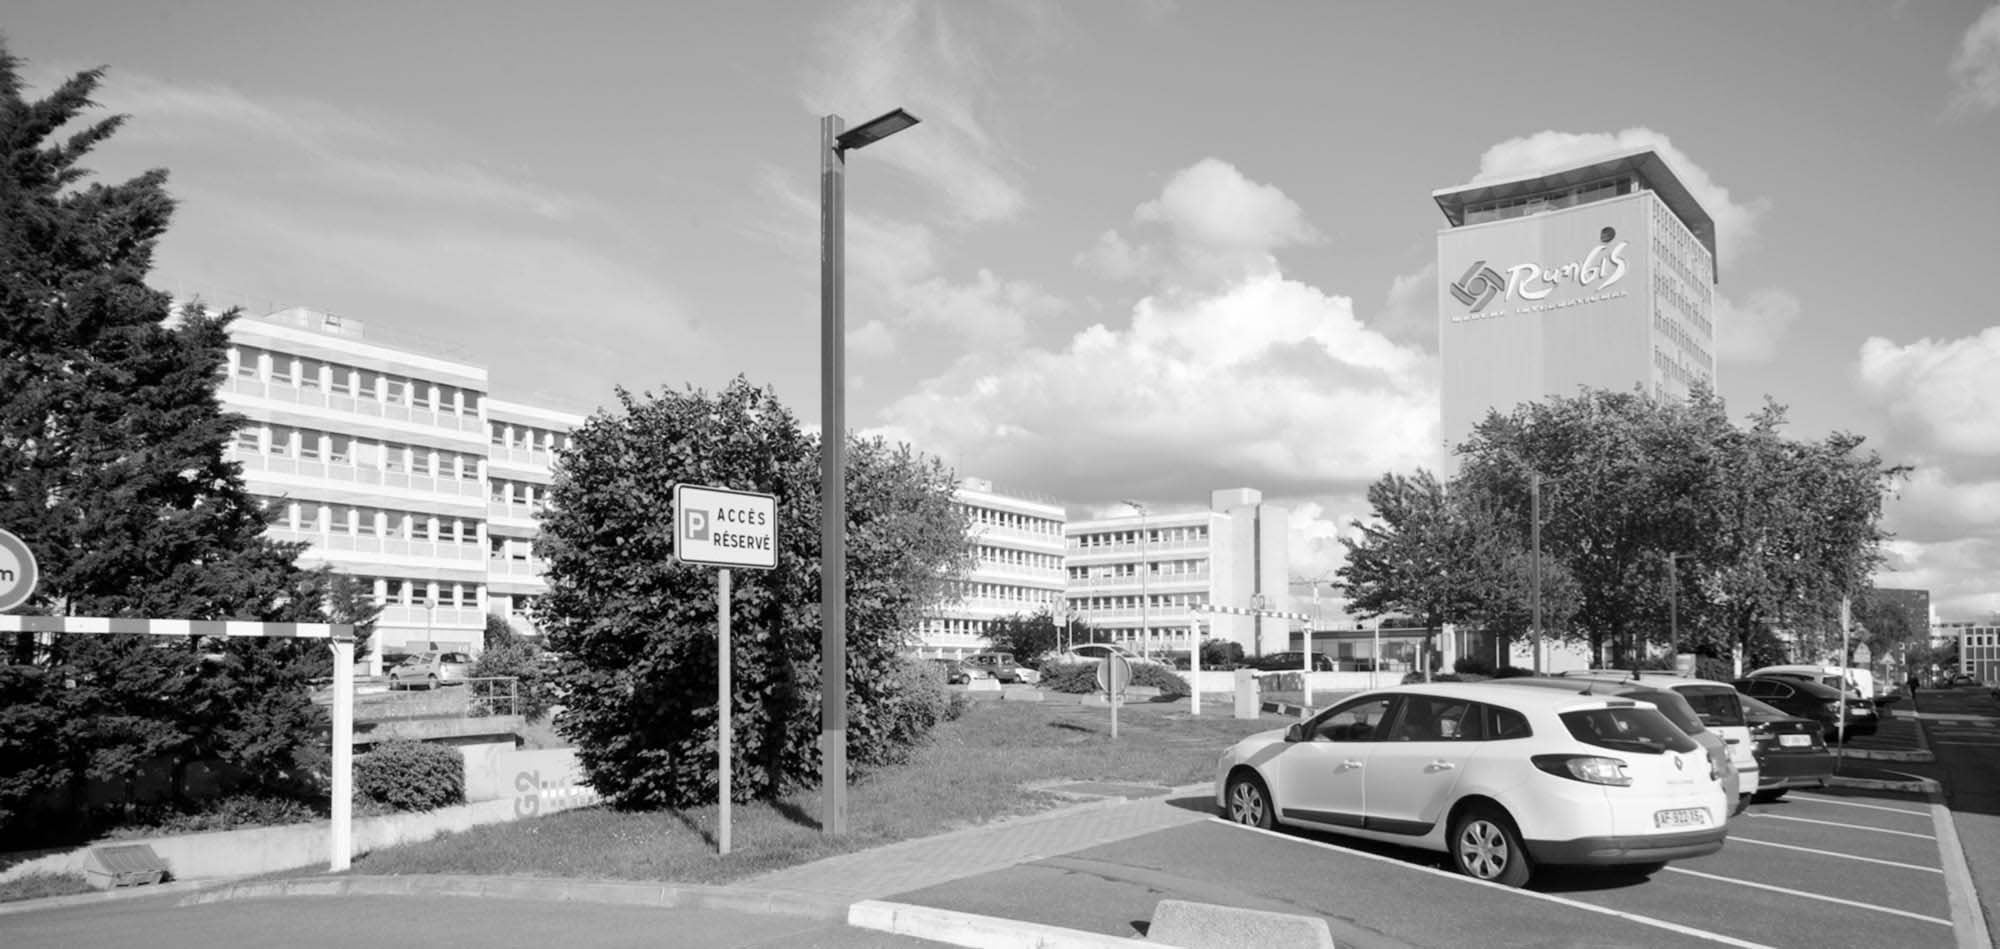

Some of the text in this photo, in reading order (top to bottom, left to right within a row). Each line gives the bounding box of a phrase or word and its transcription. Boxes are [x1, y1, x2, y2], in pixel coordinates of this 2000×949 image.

[688, 511, 705, 538] P
[717, 507, 766, 525] ACCÈS
[713, 530, 771, 551] RÉSERVÉ
[514, 770, 540, 819] G2
